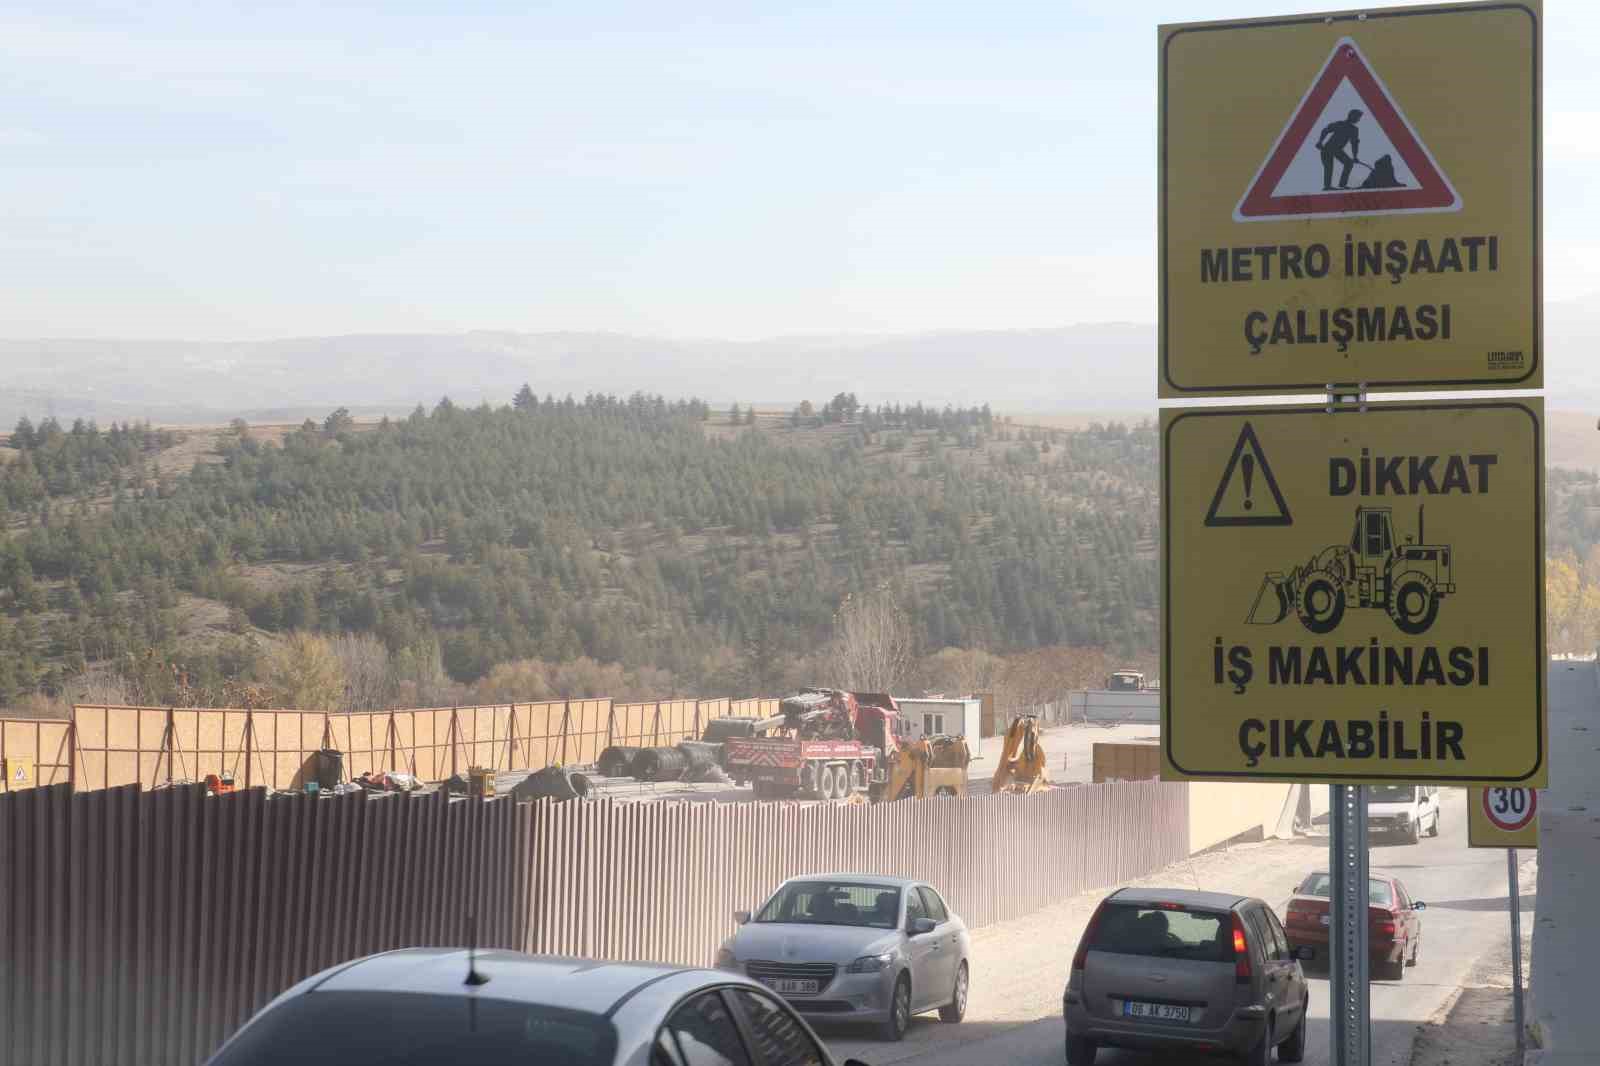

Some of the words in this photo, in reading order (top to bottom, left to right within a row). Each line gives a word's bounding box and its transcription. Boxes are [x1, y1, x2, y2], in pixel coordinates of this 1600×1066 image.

[1200, 243, 1330, 283] METRO
[1345, 234, 1499, 284] İNŞAATI
[1244, 304, 1451, 355] ÇALIŞMASI
[1329, 448, 1498, 497] DİKKAT
[1214, 636, 1253, 694] İŞ
[1268, 637, 1489, 686] MAKİNASI
[1238, 710, 1466, 767] ÇIKABİLİR
[1494, 787, 1525, 814] 30
